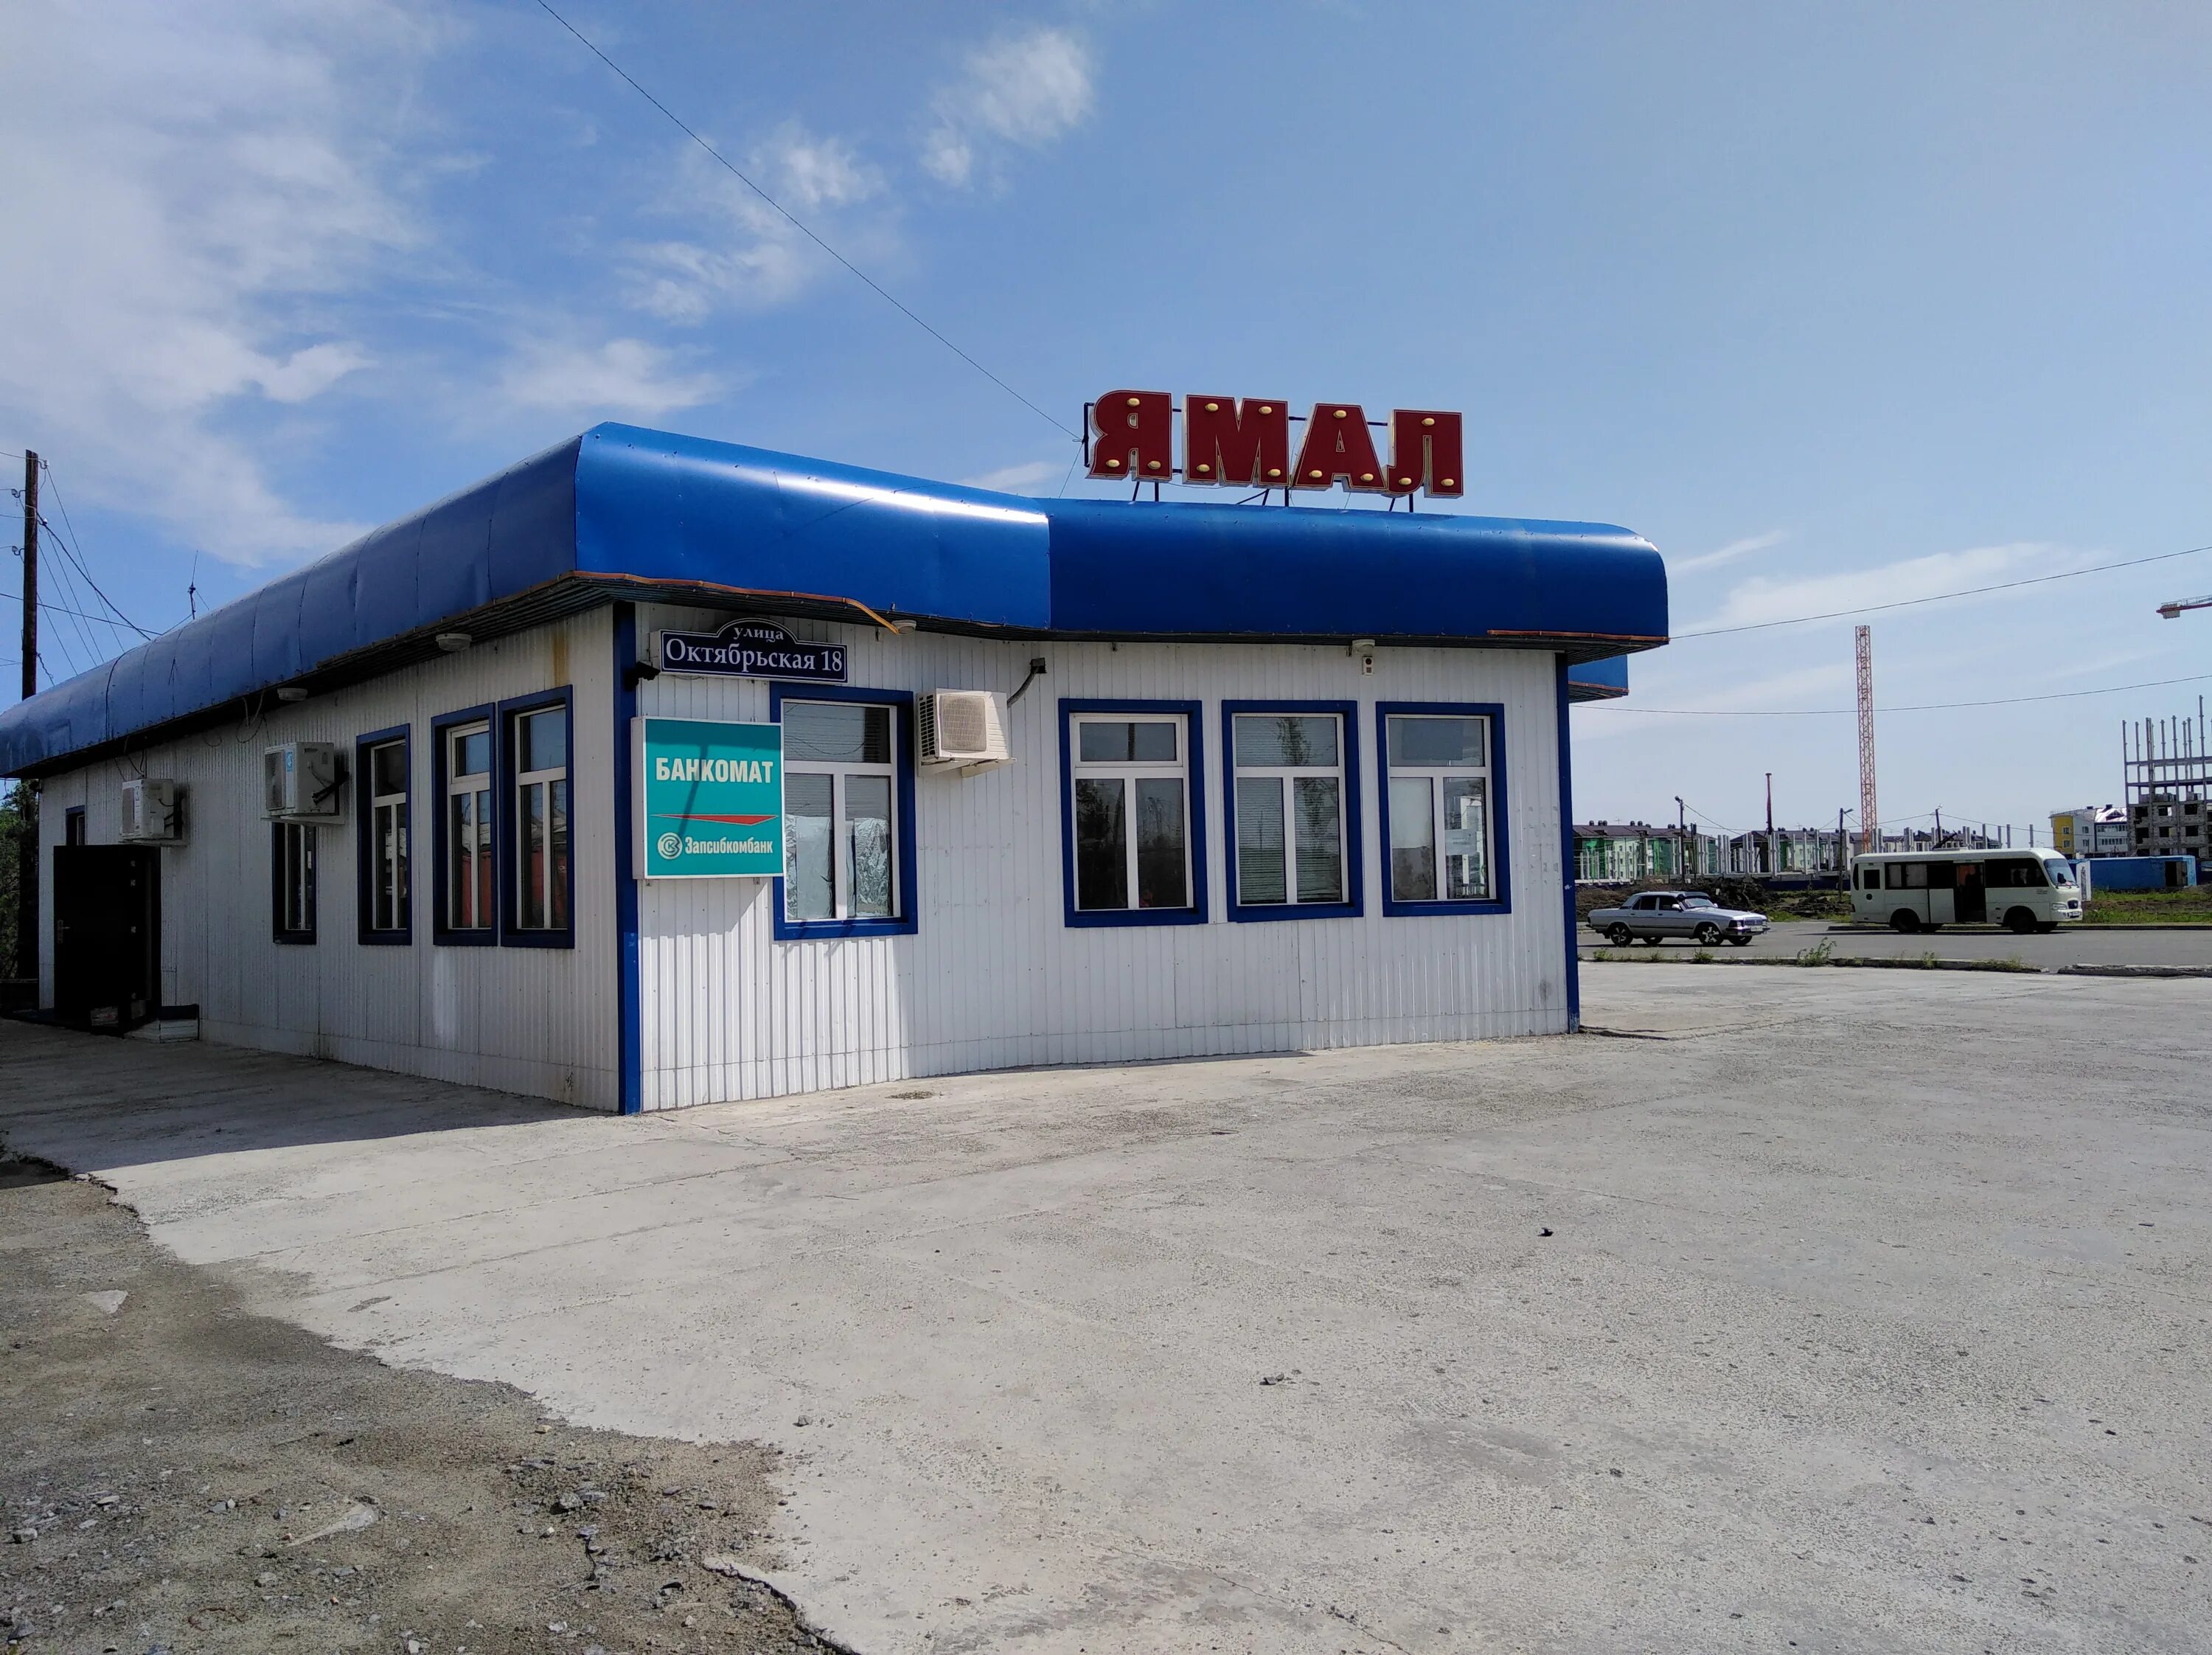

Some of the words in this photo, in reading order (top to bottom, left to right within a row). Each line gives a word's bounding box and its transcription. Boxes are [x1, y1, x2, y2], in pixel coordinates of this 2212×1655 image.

[1085, 389, 1464, 499] ЯМАЛ
[734, 627, 784, 642] улица
[666, 638, 815, 673] Октябрьская
[821, 650, 842, 672] 18
[655, 757, 773, 783] БАНКОМАТ
[684, 836, 773, 854] Запсибкомбанк
